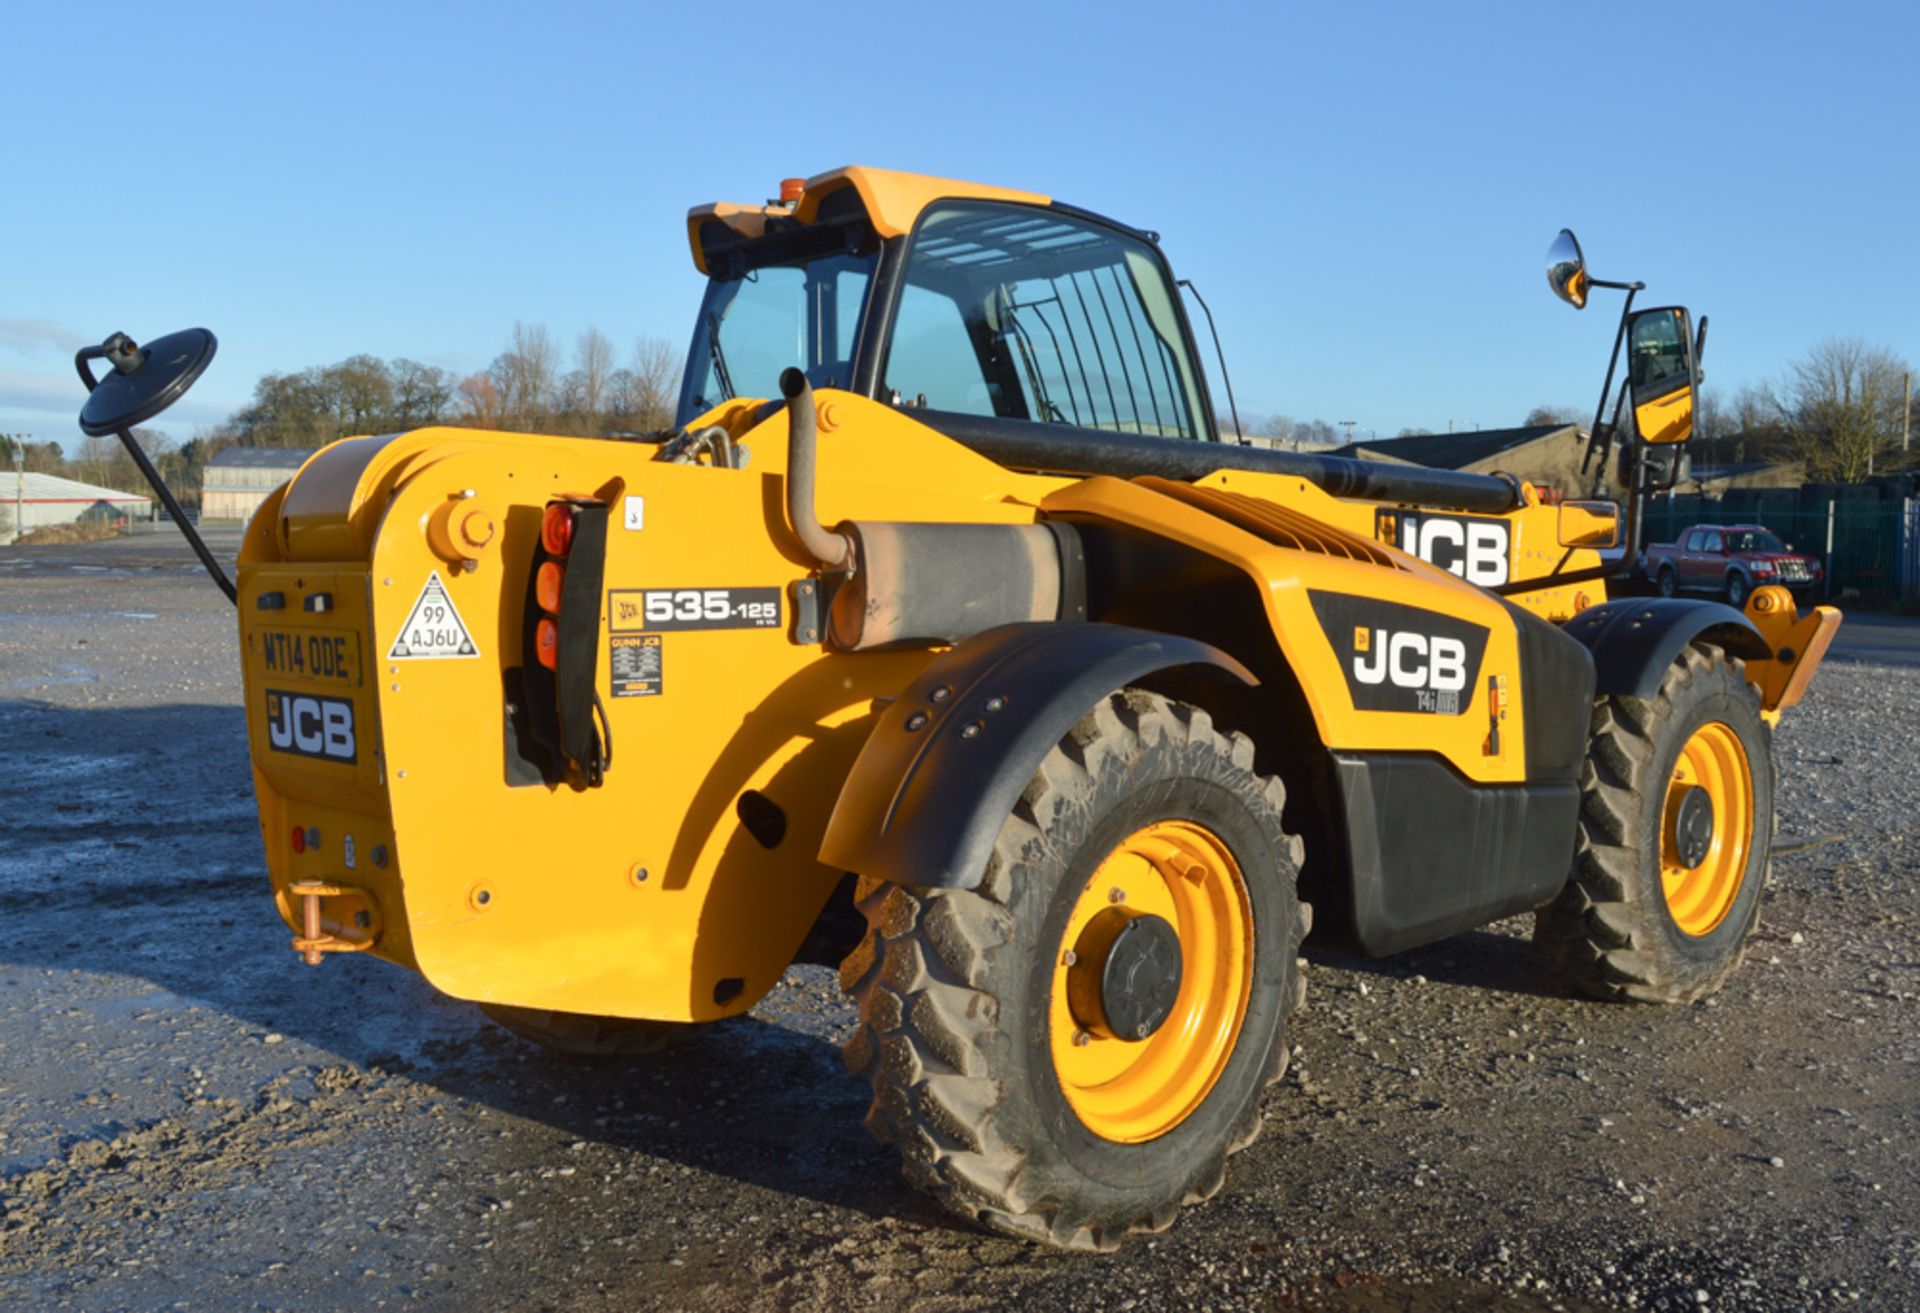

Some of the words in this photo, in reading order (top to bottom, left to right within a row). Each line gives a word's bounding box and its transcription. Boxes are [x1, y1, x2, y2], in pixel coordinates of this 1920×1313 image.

[423, 605, 446, 624] 99
[411, 629, 458, 648] AJ6U
[1353, 628, 1466, 691] JCB
[269, 695, 356, 759] JCB
